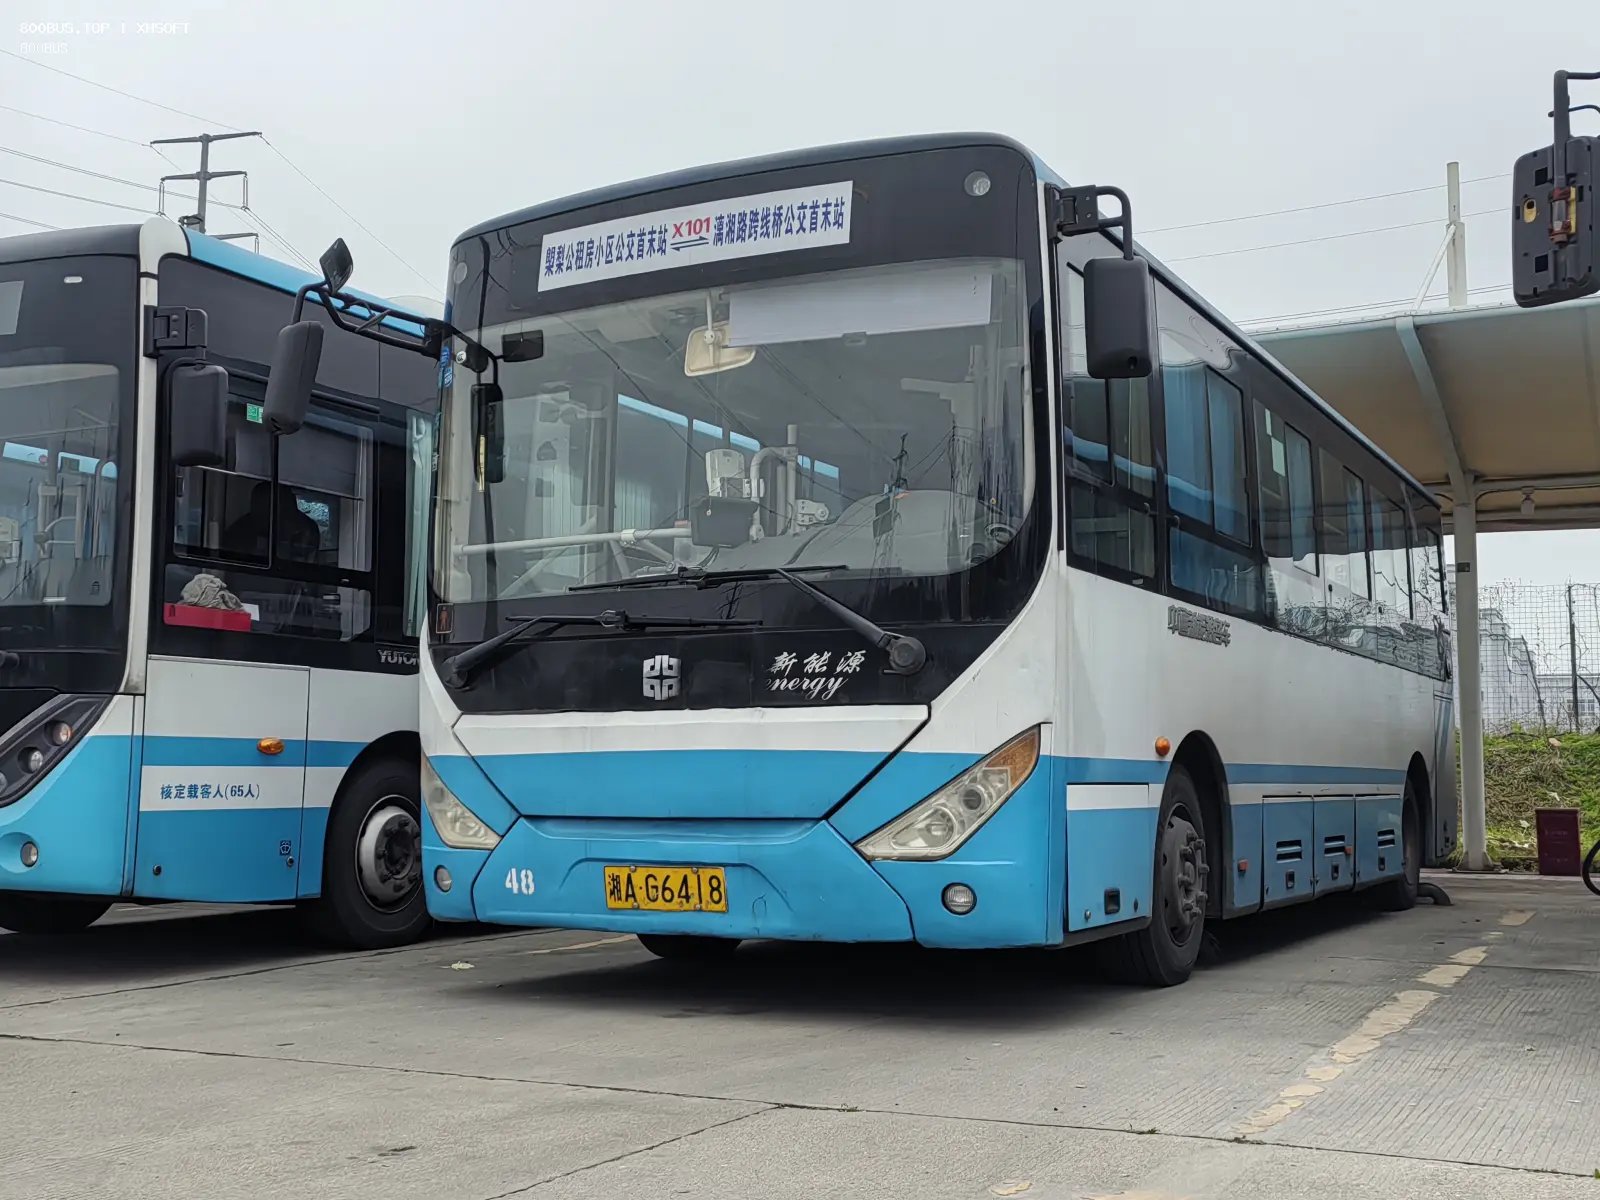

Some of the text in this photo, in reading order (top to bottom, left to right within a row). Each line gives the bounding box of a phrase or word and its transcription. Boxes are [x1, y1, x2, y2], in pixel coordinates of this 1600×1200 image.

[672, 216, 711, 239] X101
[713, 196, 846, 246] 潇湘路跨线桥公交首末站
[765, 650, 867, 677] 新能源
[160, 783, 260, 800] 核定载客人(65人)
[505, 867, 535, 895] 48
